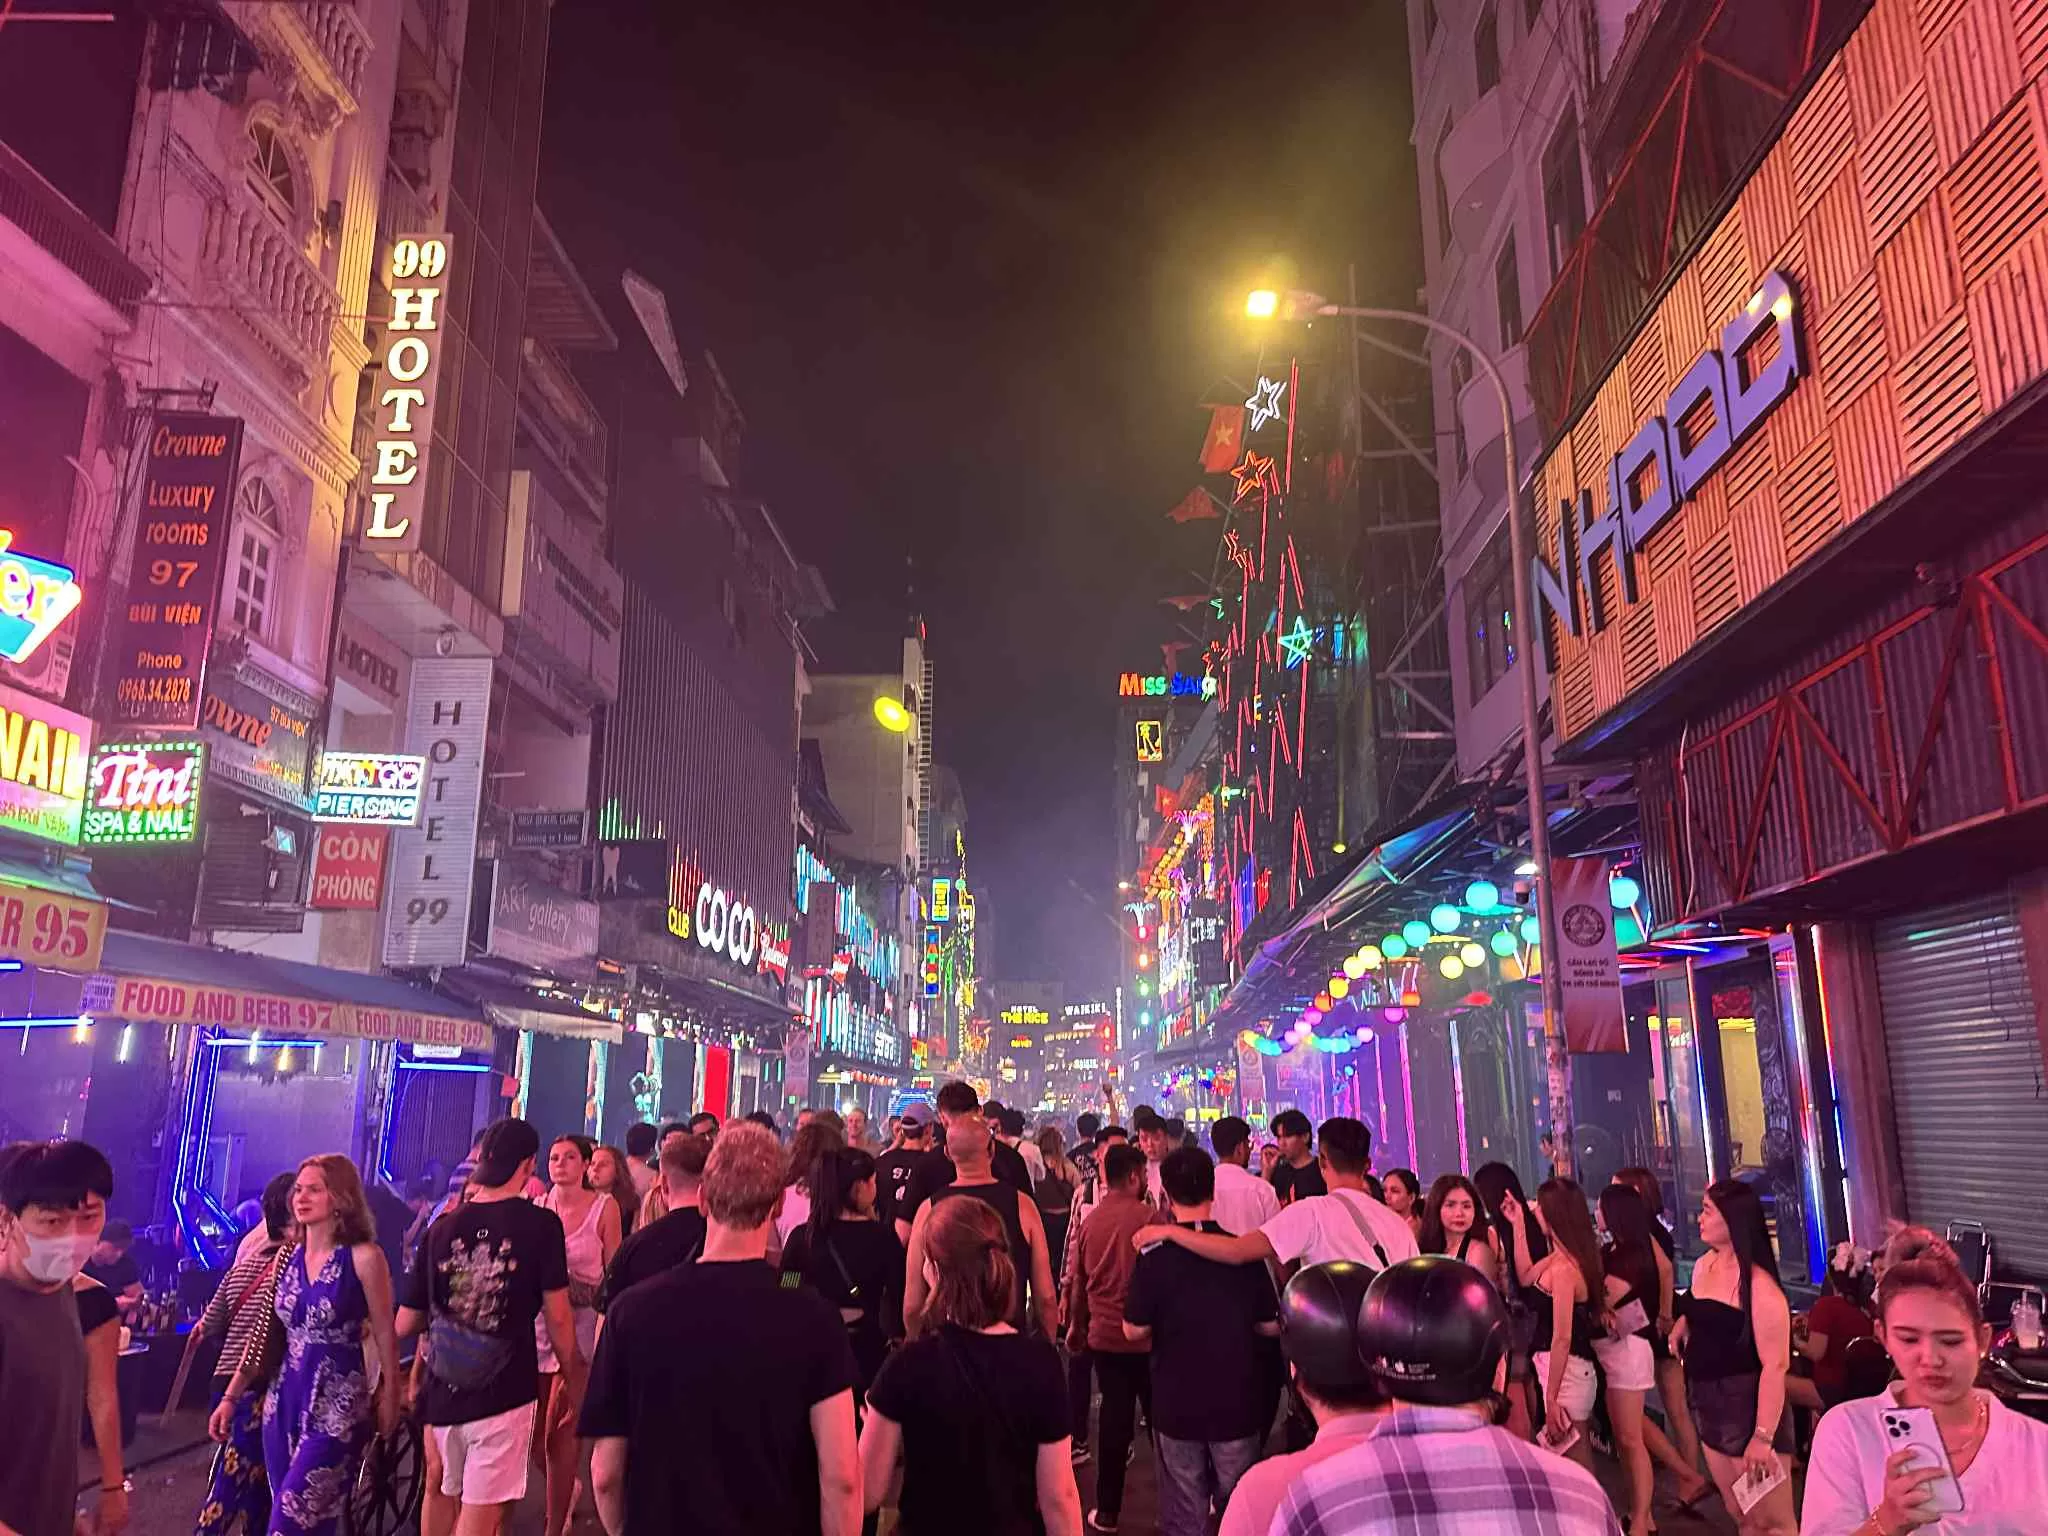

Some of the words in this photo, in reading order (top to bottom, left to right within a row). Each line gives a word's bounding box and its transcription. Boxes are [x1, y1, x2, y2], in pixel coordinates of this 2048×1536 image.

[392, 240, 446, 278] 99
[366, 287, 440, 538] HOTEL
[152, 425, 227, 457] Crowne
[1532, 269, 1810, 670] NHOOD
[149, 480, 215, 513] Luxury
[146, 522, 209, 546] rooms
[150, 560, 199, 588] 97
[137, 651, 183, 669] Phone
[118, 676, 191, 702] 0968.34.2878
[270, 703, 281, 725] 97
[0, 705, 86, 801] NAIL
[96, 750, 196, 807] Tini
[421, 700, 462, 881] HOTEL
[317, 793, 417, 817] PIERCING
[89, 812, 123, 834] SPA
[130, 813, 143, 833] &
[147, 812, 191, 834] NAIL
[323, 830, 381, 863] CÒN
[315, 869, 376, 904] PHÒNG
[499, 882, 529, 918] ART
[0, 895, 24, 948] R
[32, 903, 90, 957] 95
[406, 898, 448, 925] 99
[527, 897, 571, 945] gallery
[668, 906, 691, 939] CLUB
[122, 982, 186, 1018] FOOD
[191, 991, 236, 1023] AND
[242, 996, 291, 1029] BEER
[298, 1003, 332, 1030] 97
[1064, 1002, 1106, 1016] WAIKIKI
[355, 1009, 391, 1034] FOOD
[395, 1014, 422, 1040] AND
[425, 1017, 457, 1043] BEER
